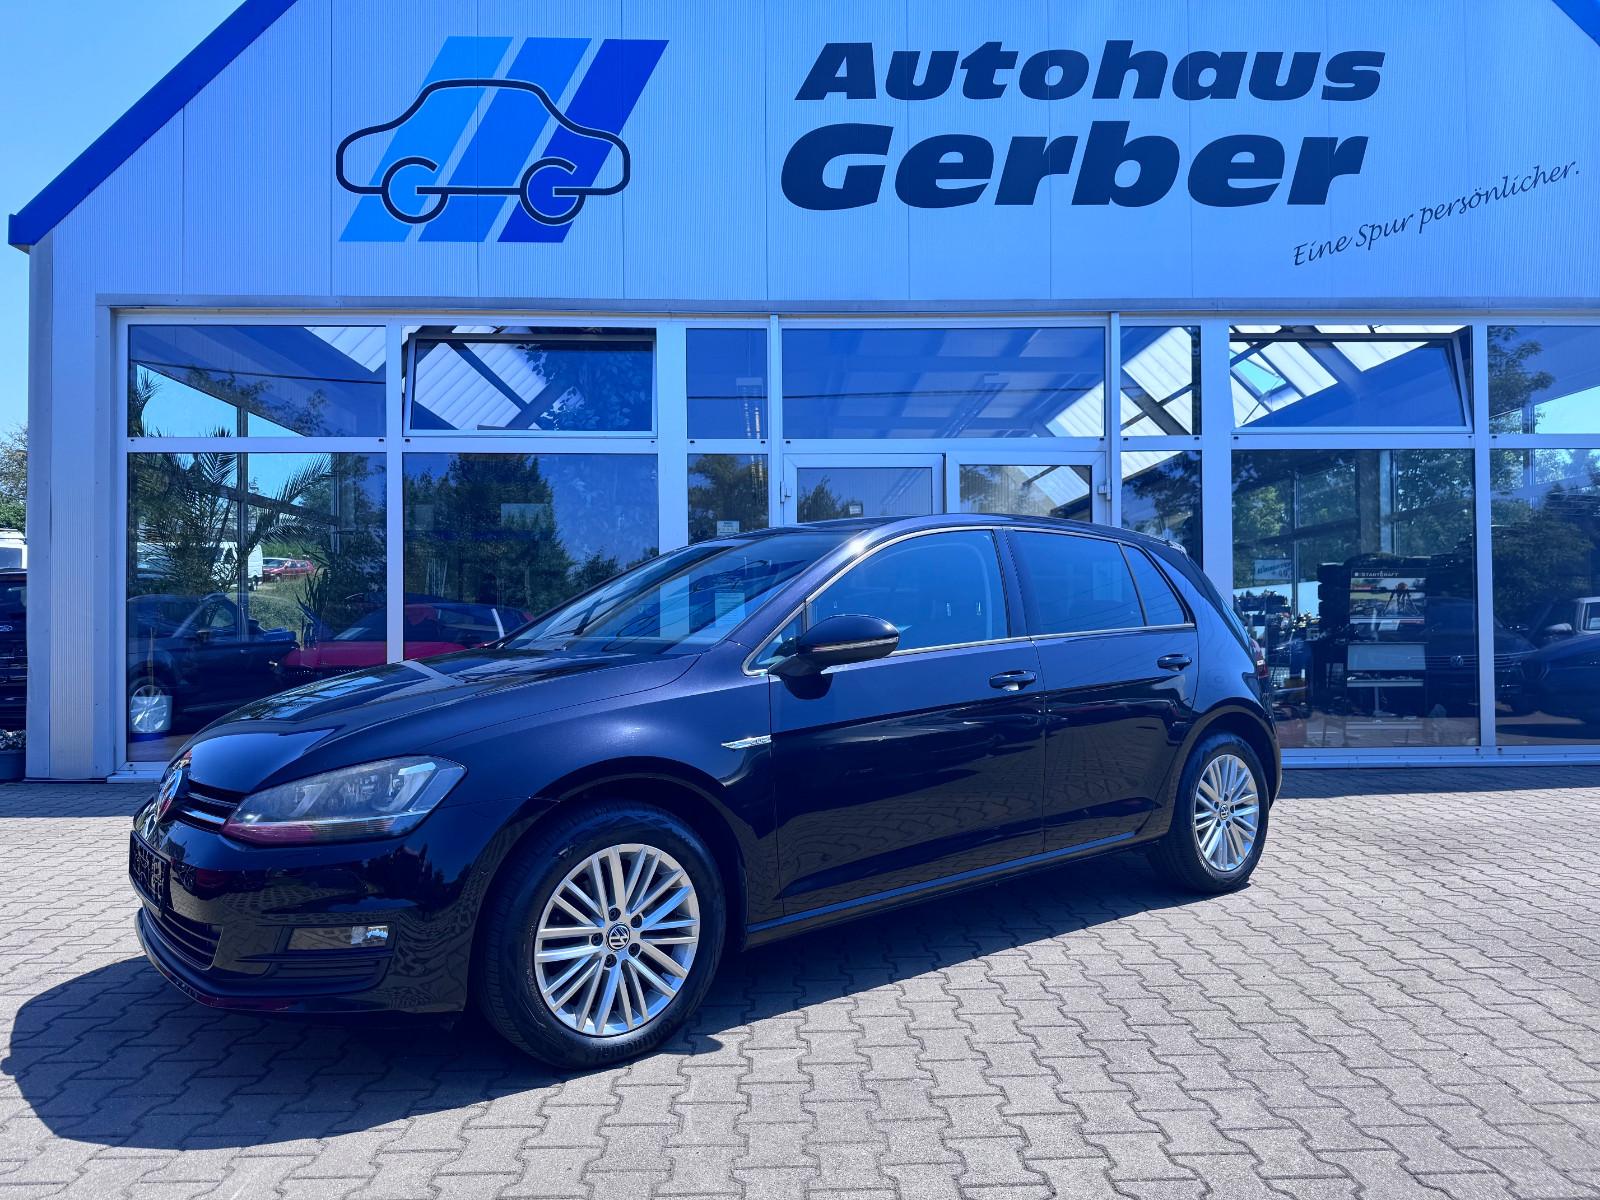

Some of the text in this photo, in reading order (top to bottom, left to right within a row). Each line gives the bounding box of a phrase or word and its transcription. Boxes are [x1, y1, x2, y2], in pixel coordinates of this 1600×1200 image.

[795, 40, 1385, 102] Autohaus
[781, 121, 1368, 210] Gerber
[1293, 160, 1580, 266] Eine Spur persönlicher.
